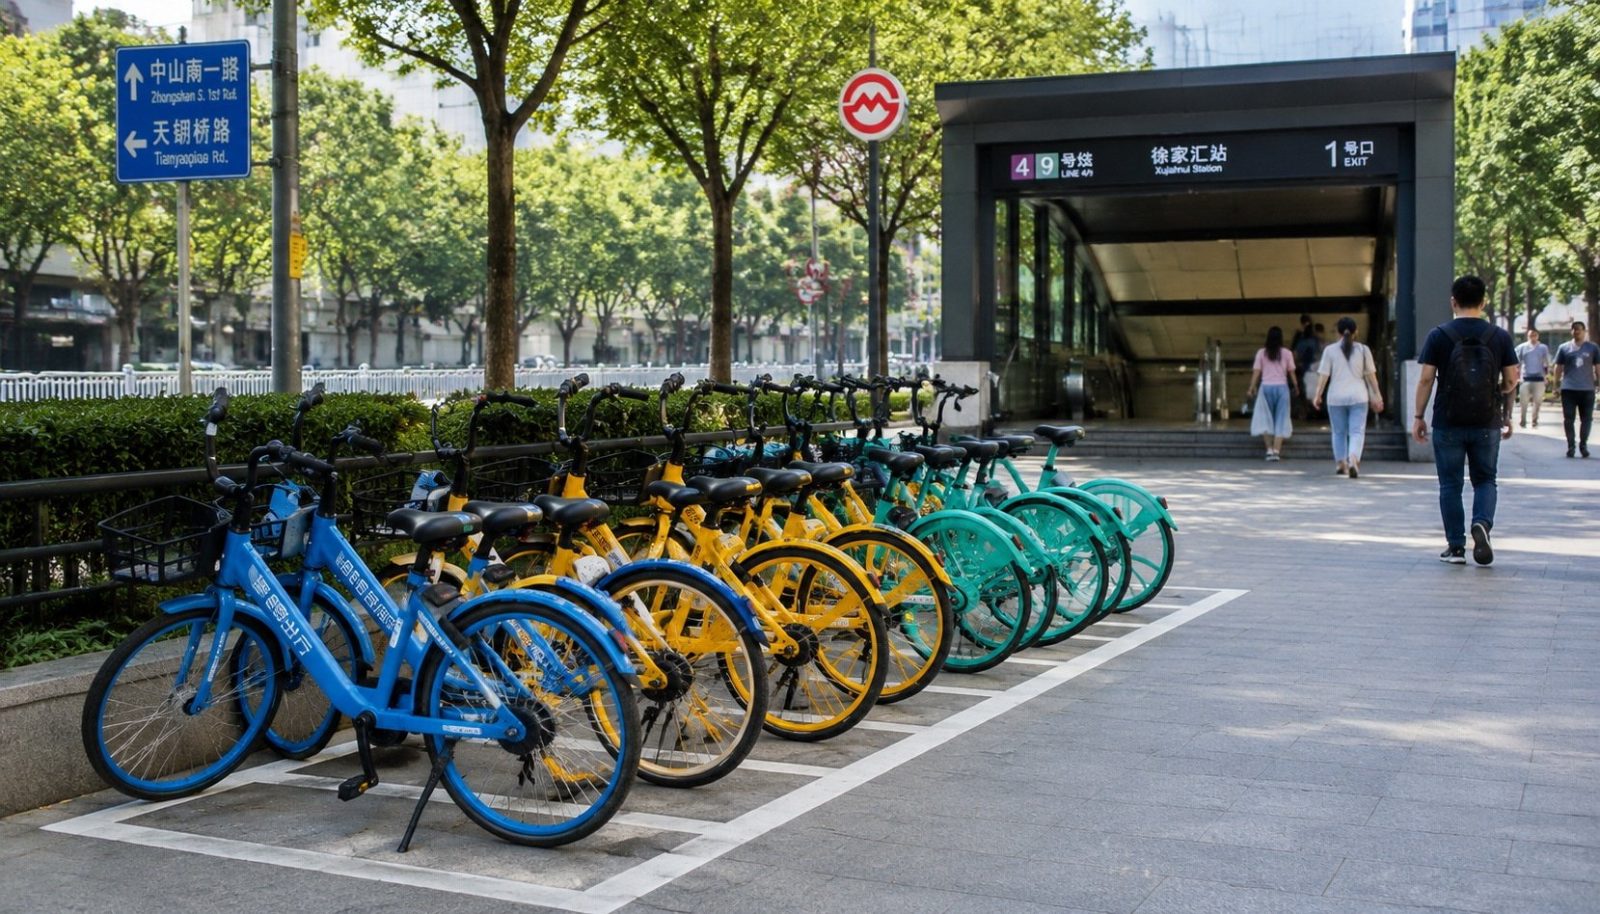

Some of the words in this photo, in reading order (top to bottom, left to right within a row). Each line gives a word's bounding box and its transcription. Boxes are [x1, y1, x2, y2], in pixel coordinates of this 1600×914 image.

[150, 56, 239, 85] 中山南一路
[197, 88, 206, 101] S.
[208, 88, 220, 101] 1st
[212, 148, 229, 164] Rd.
[1151, 143, 1227, 165] 徐家汇站
[1325, 140, 1337, 168] 1
[1344, 140, 1374, 156] 号口
[1015, 157, 1030, 177] 4
[1040, 156, 1054, 176] 9
[1344, 156, 1369, 167] EXIT
